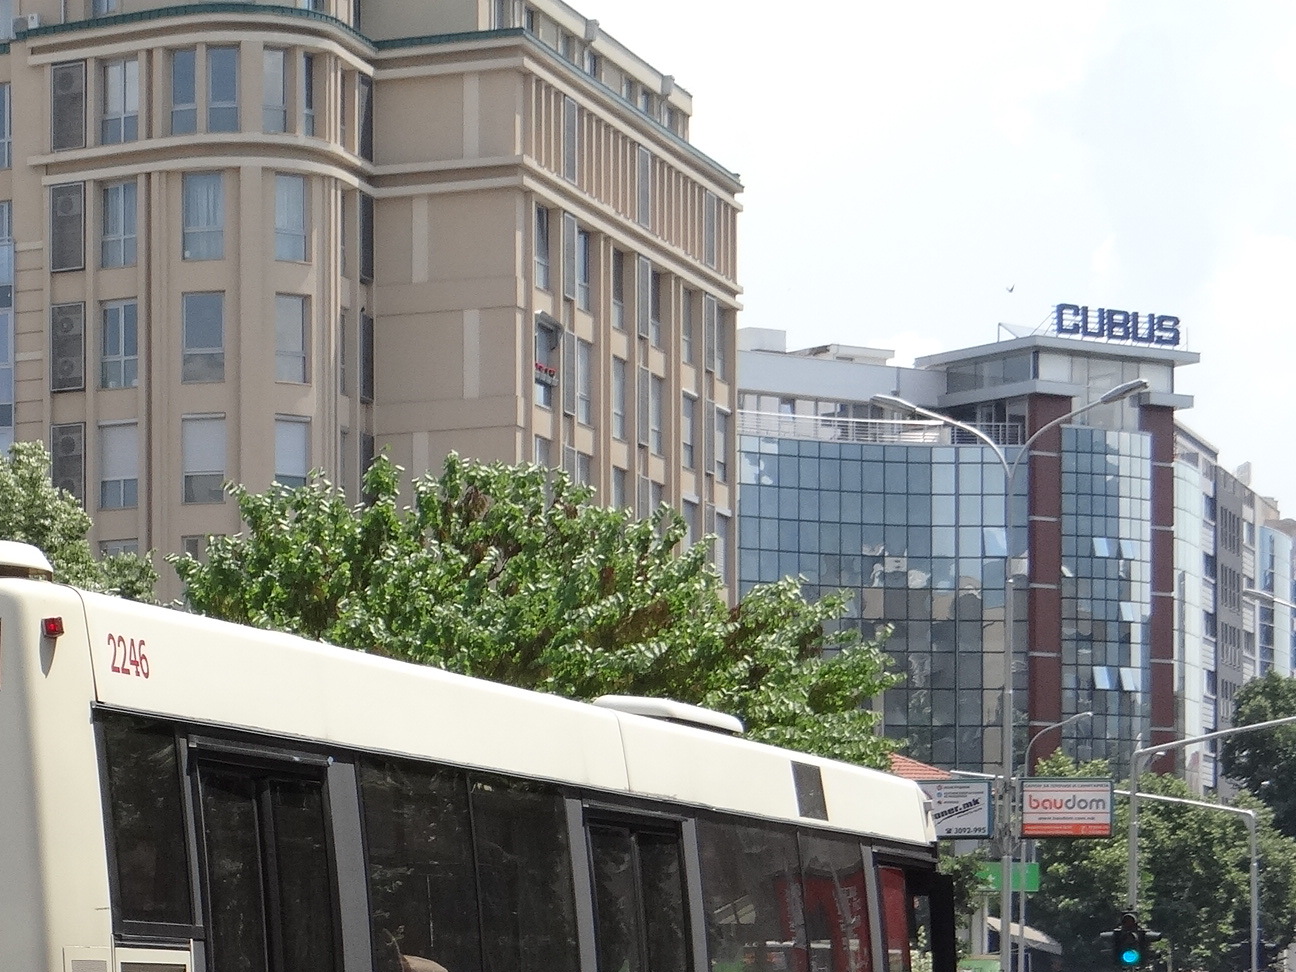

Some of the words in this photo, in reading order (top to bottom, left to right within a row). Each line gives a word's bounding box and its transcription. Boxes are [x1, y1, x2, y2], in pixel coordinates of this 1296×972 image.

[1056, 303, 1180, 346] CUBUS
[107, 633, 150, 679] 2246
[933, 798, 981, 820] oner.mk
[1028, 794, 1106, 810] baudom
